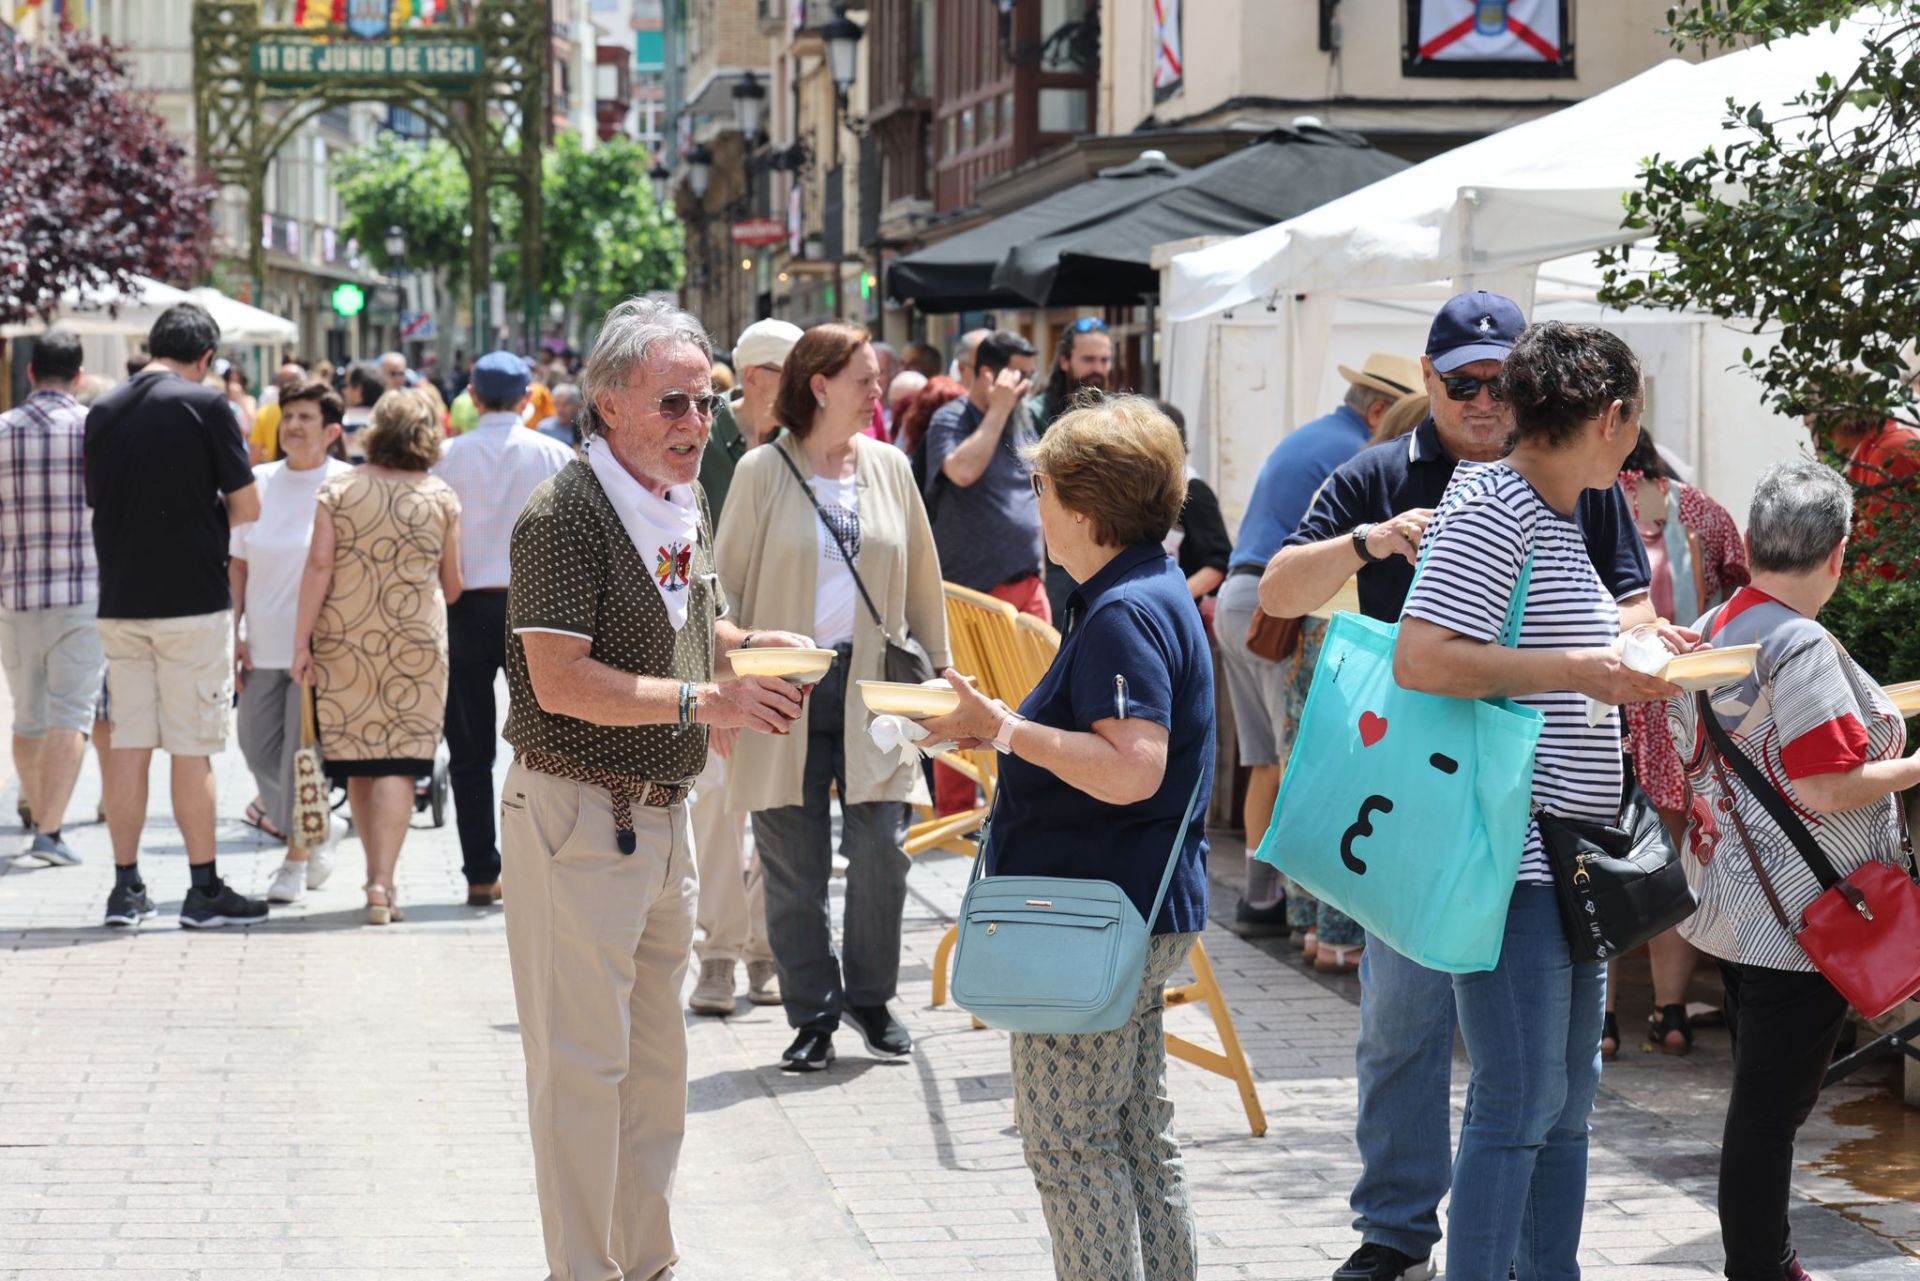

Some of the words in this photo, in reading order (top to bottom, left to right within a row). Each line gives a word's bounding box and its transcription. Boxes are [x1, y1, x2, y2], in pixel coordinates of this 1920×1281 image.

[259, 47, 278, 72] 11
[282, 47, 314, 72] DE
[317, 47, 386, 72] JUNIO
[390, 47, 421, 72] DE
[426, 47, 475, 72] 1521
[1590, 921, 1602, 939] LIFE
